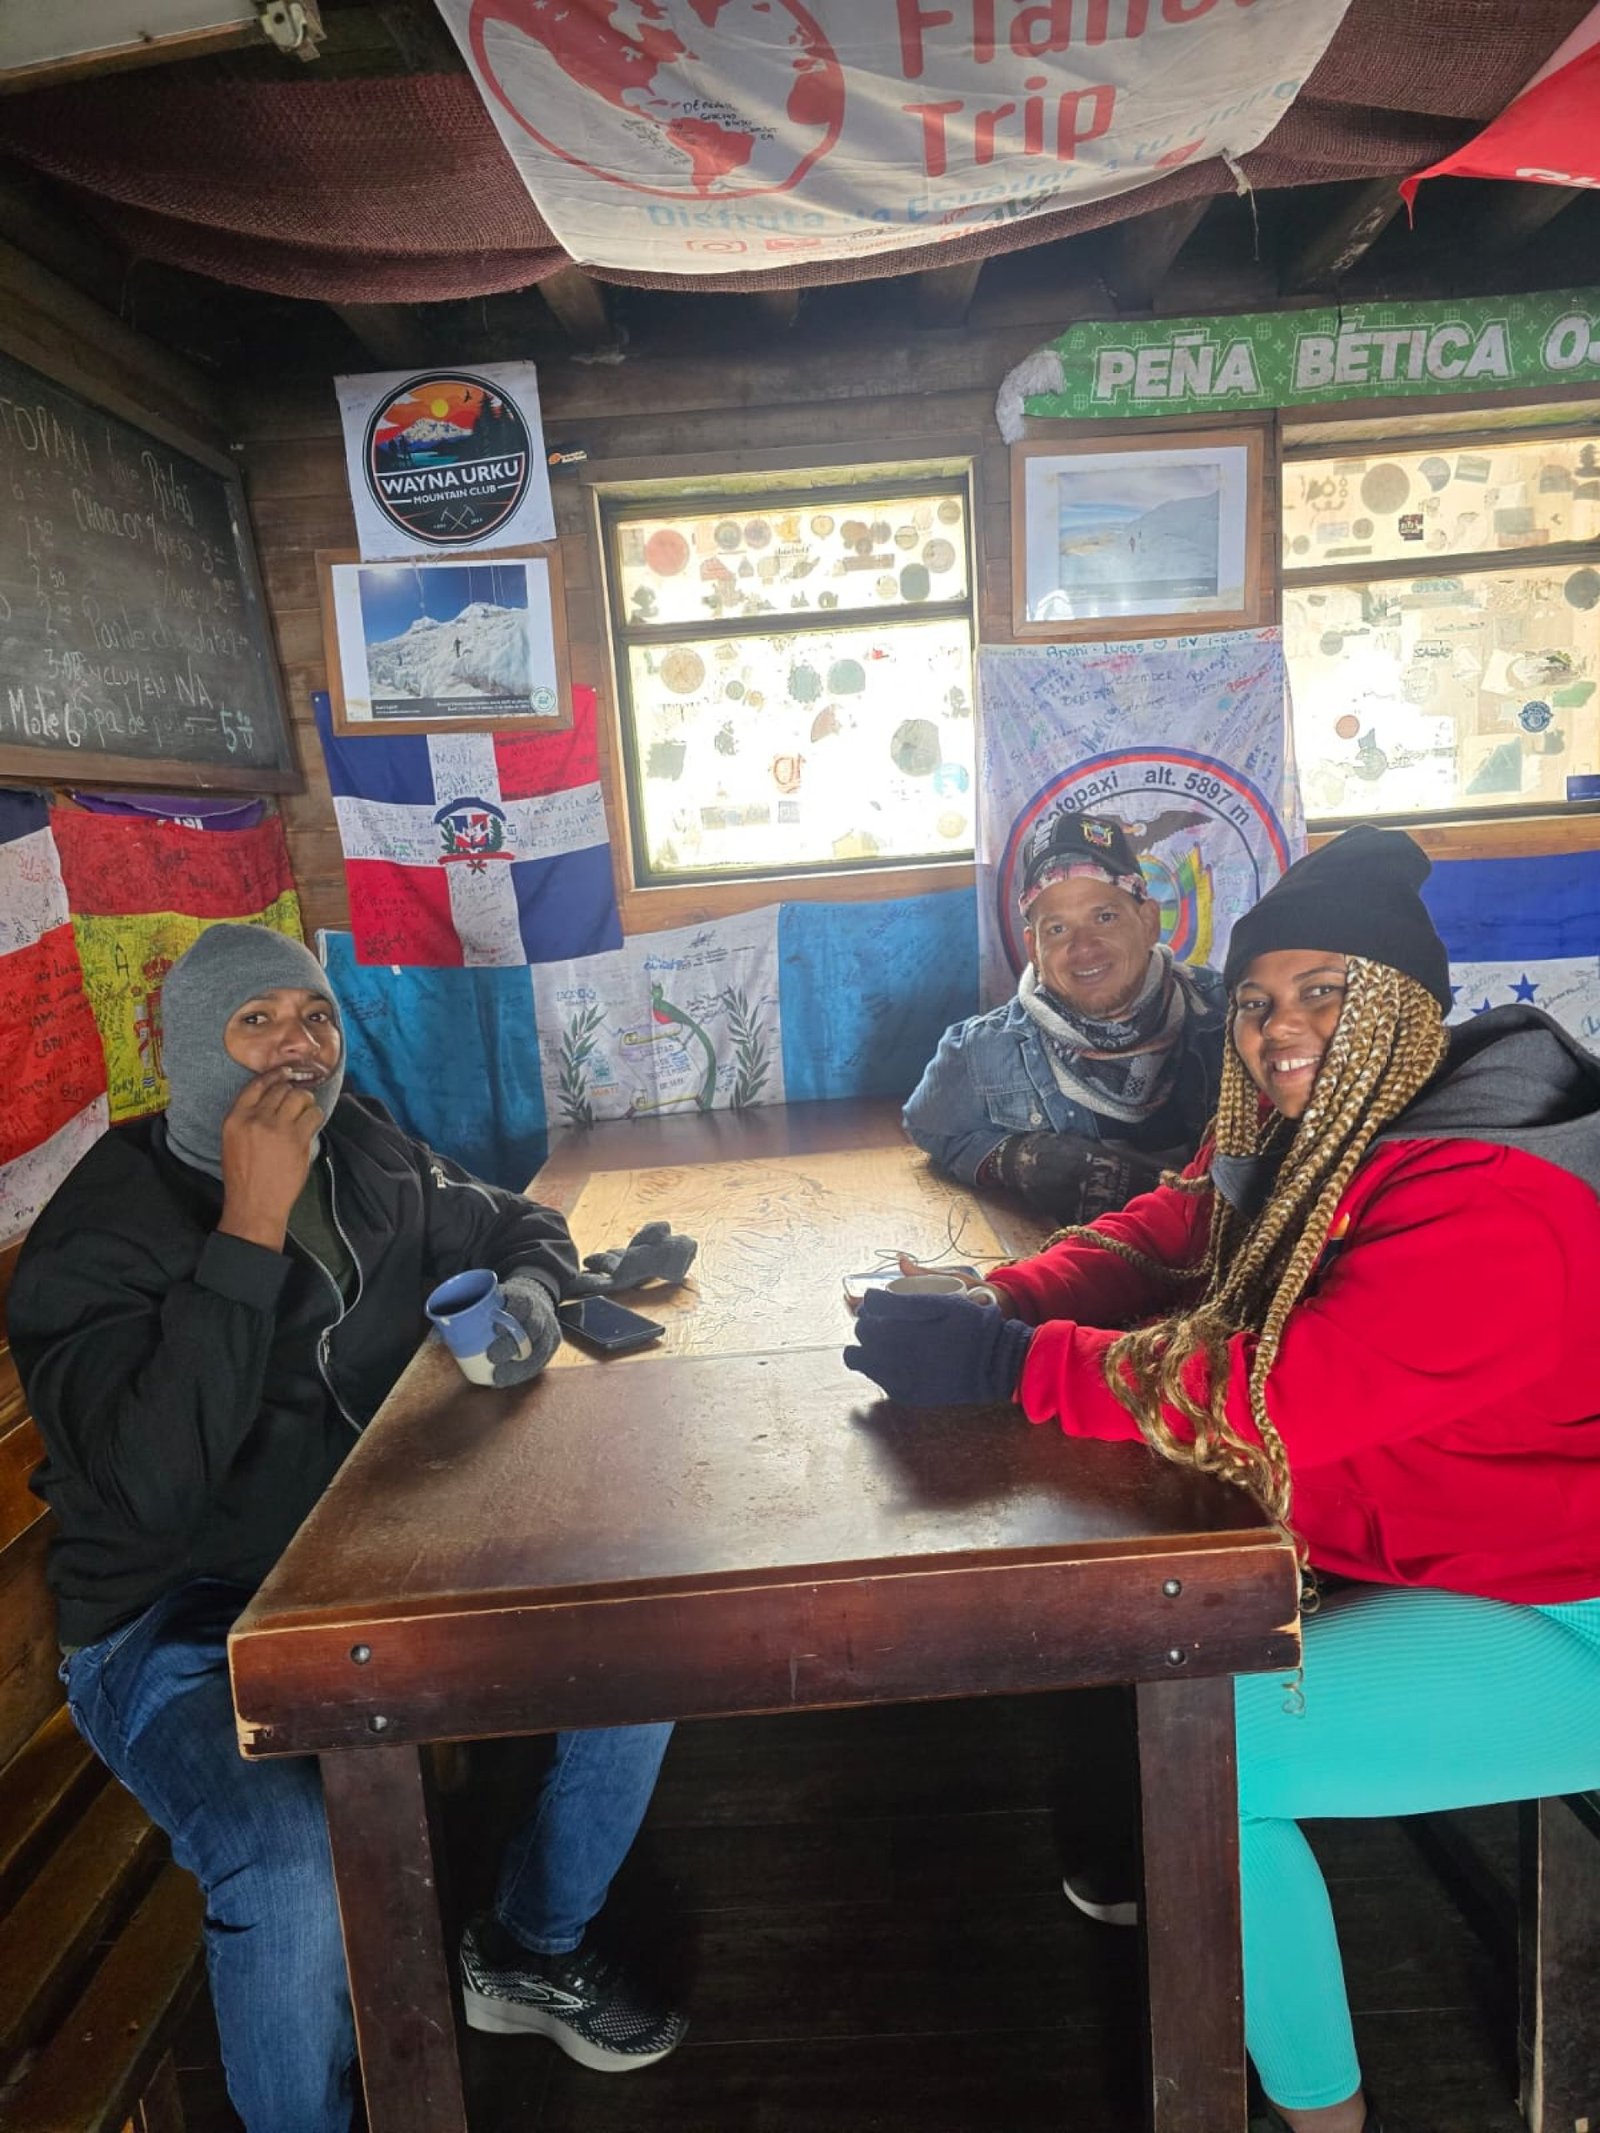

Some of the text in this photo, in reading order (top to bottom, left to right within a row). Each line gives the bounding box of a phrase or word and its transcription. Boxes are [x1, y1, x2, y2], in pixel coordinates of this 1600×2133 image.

[902, 76, 1117, 178] Trip
[1094, 331, 1261, 401] PEÑA
[1292, 319, 1512, 390] BÉTICA
[382, 460, 519, 495] WAYNA URKU
[413, 486, 497, 505] MOUNTAIN CLUB
[1035, 766, 1250, 830] otopaxi alt. 5897 m
